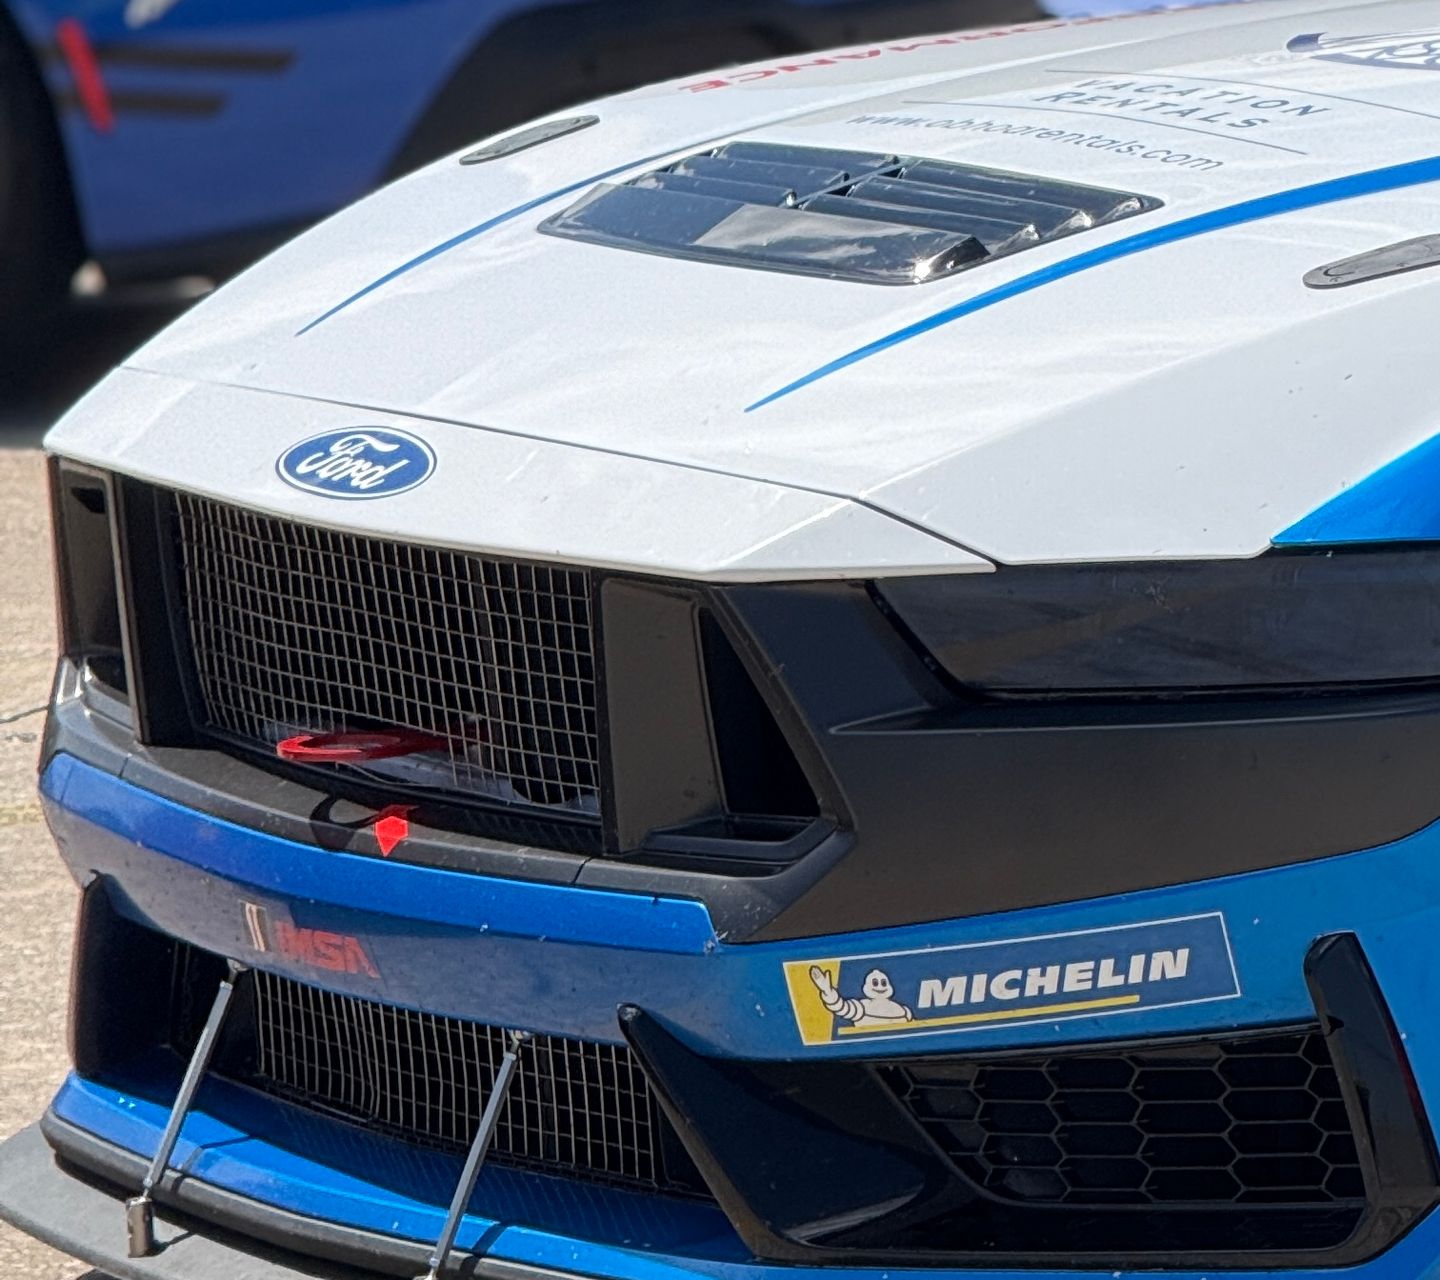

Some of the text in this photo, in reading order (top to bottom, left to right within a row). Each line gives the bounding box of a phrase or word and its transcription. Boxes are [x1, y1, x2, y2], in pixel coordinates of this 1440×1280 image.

[1034, 91, 1272, 131] RENTALS
[1076, 78, 1330, 118] VACATION
[298, 432, 408, 490] Ford
[917, 947, 1190, 1009] MICHELIN
